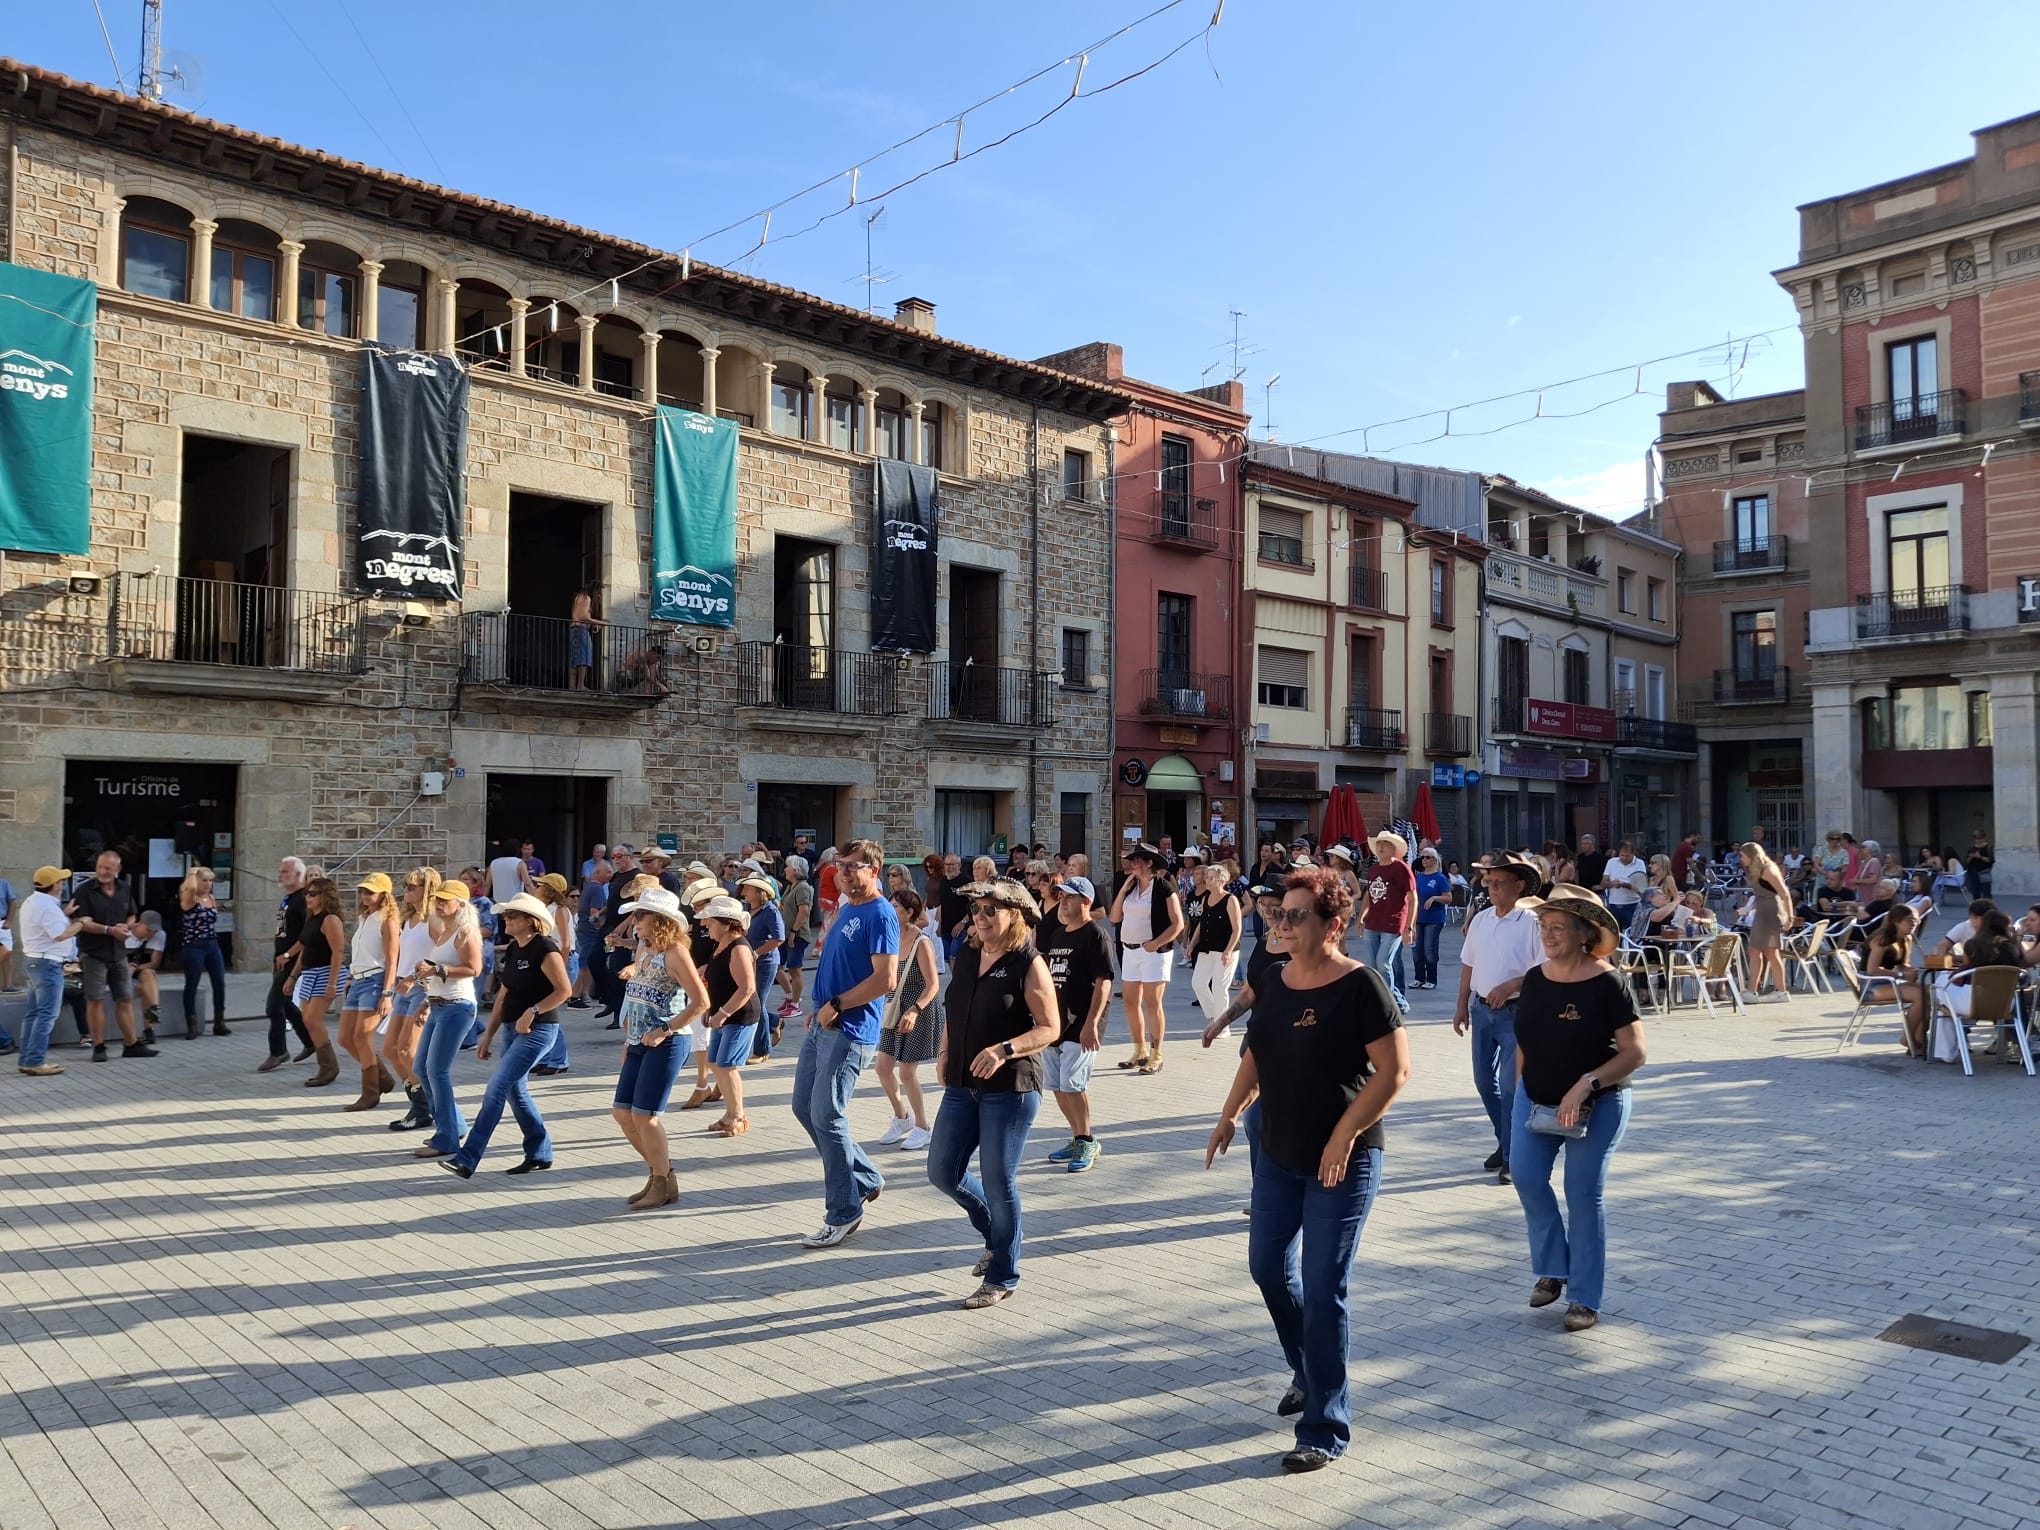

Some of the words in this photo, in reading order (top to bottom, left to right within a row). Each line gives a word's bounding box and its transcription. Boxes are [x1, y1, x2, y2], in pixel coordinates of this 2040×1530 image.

[3, 363, 45, 378] mont
[392, 551, 431, 566] mont
[678, 580, 712, 593] mont
[660, 588, 729, 615] Senys
[94, 778, 180, 796] Turisme
